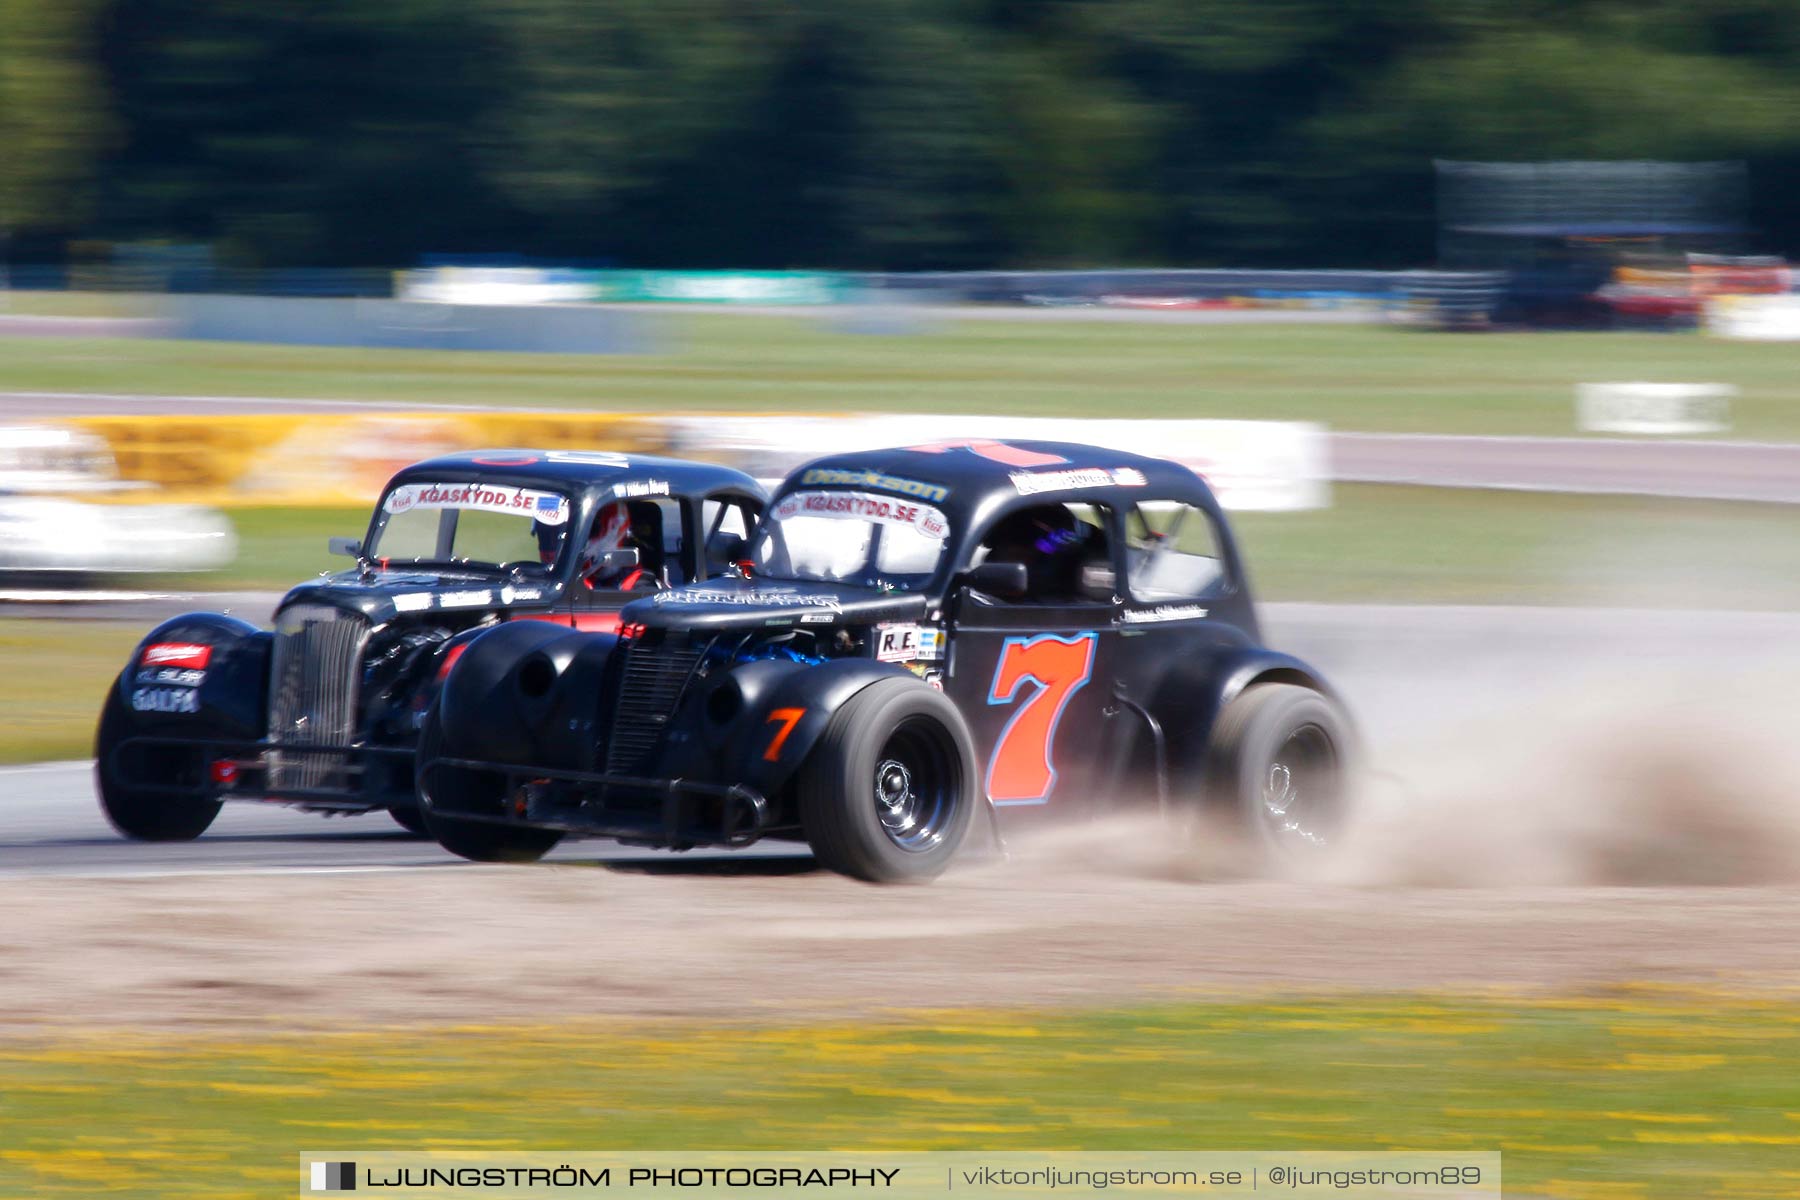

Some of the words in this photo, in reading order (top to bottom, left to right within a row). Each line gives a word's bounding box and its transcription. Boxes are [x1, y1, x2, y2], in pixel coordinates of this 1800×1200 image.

[419, 489, 534, 510] KGASKYDD.SE
[805, 496, 918, 523] KGASKYDD.SE
[763, 707, 806, 761] 7
[985, 631, 1099, 806] 7
